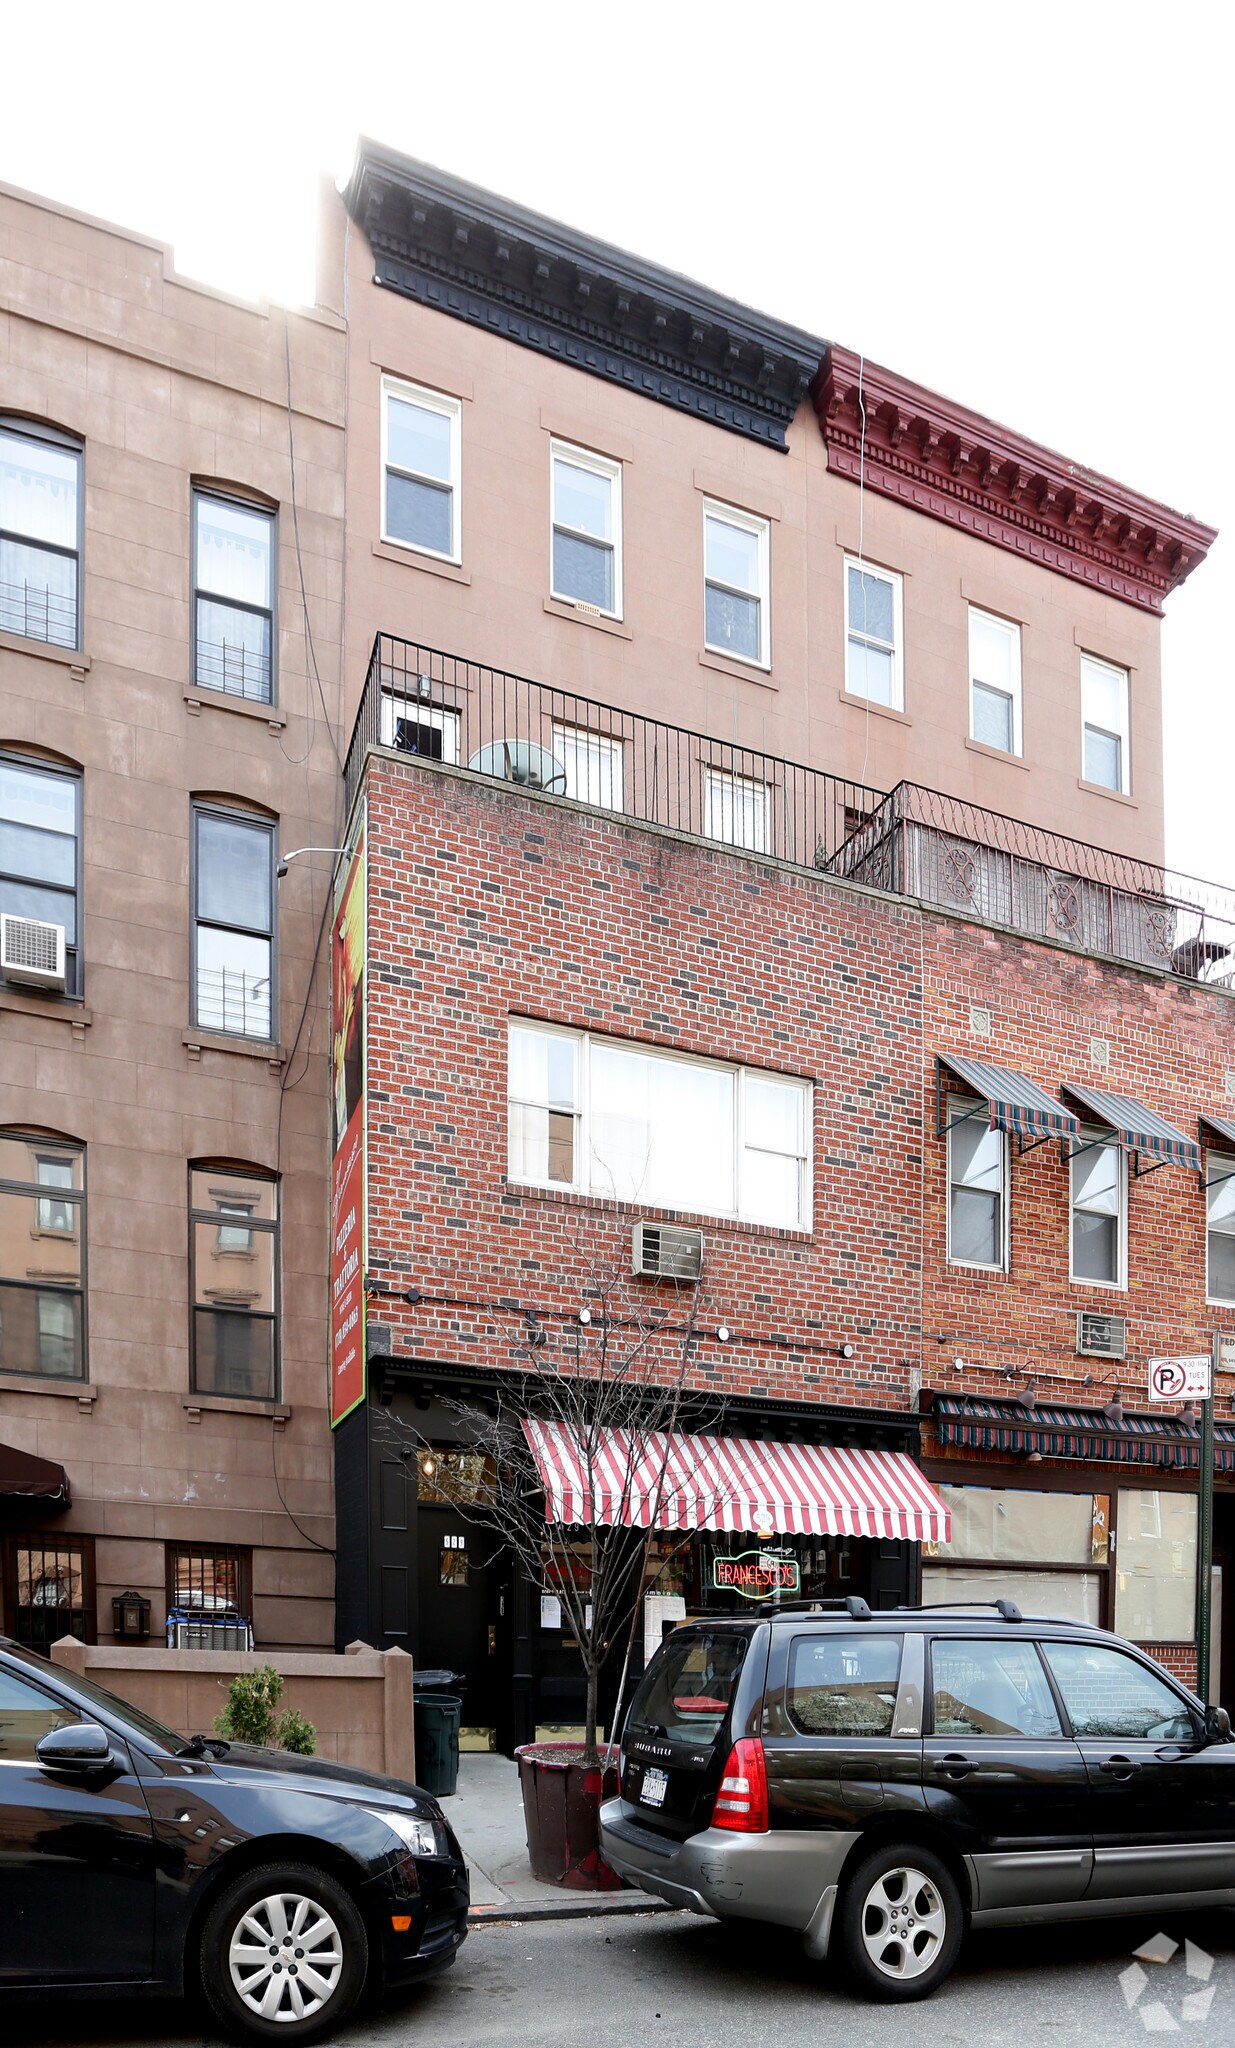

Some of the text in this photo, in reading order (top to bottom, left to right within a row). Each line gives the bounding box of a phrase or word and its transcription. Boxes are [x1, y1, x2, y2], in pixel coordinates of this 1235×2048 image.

[334, 1247, 358, 1300] TRATTORIA
[1189, 1371, 1206, 1379] TUES
[445, 1536, 464, 1548] 529
[717, 1563, 796, 1587] FRANCESCO'S
[634, 1742, 672, 1756] SUBARU
